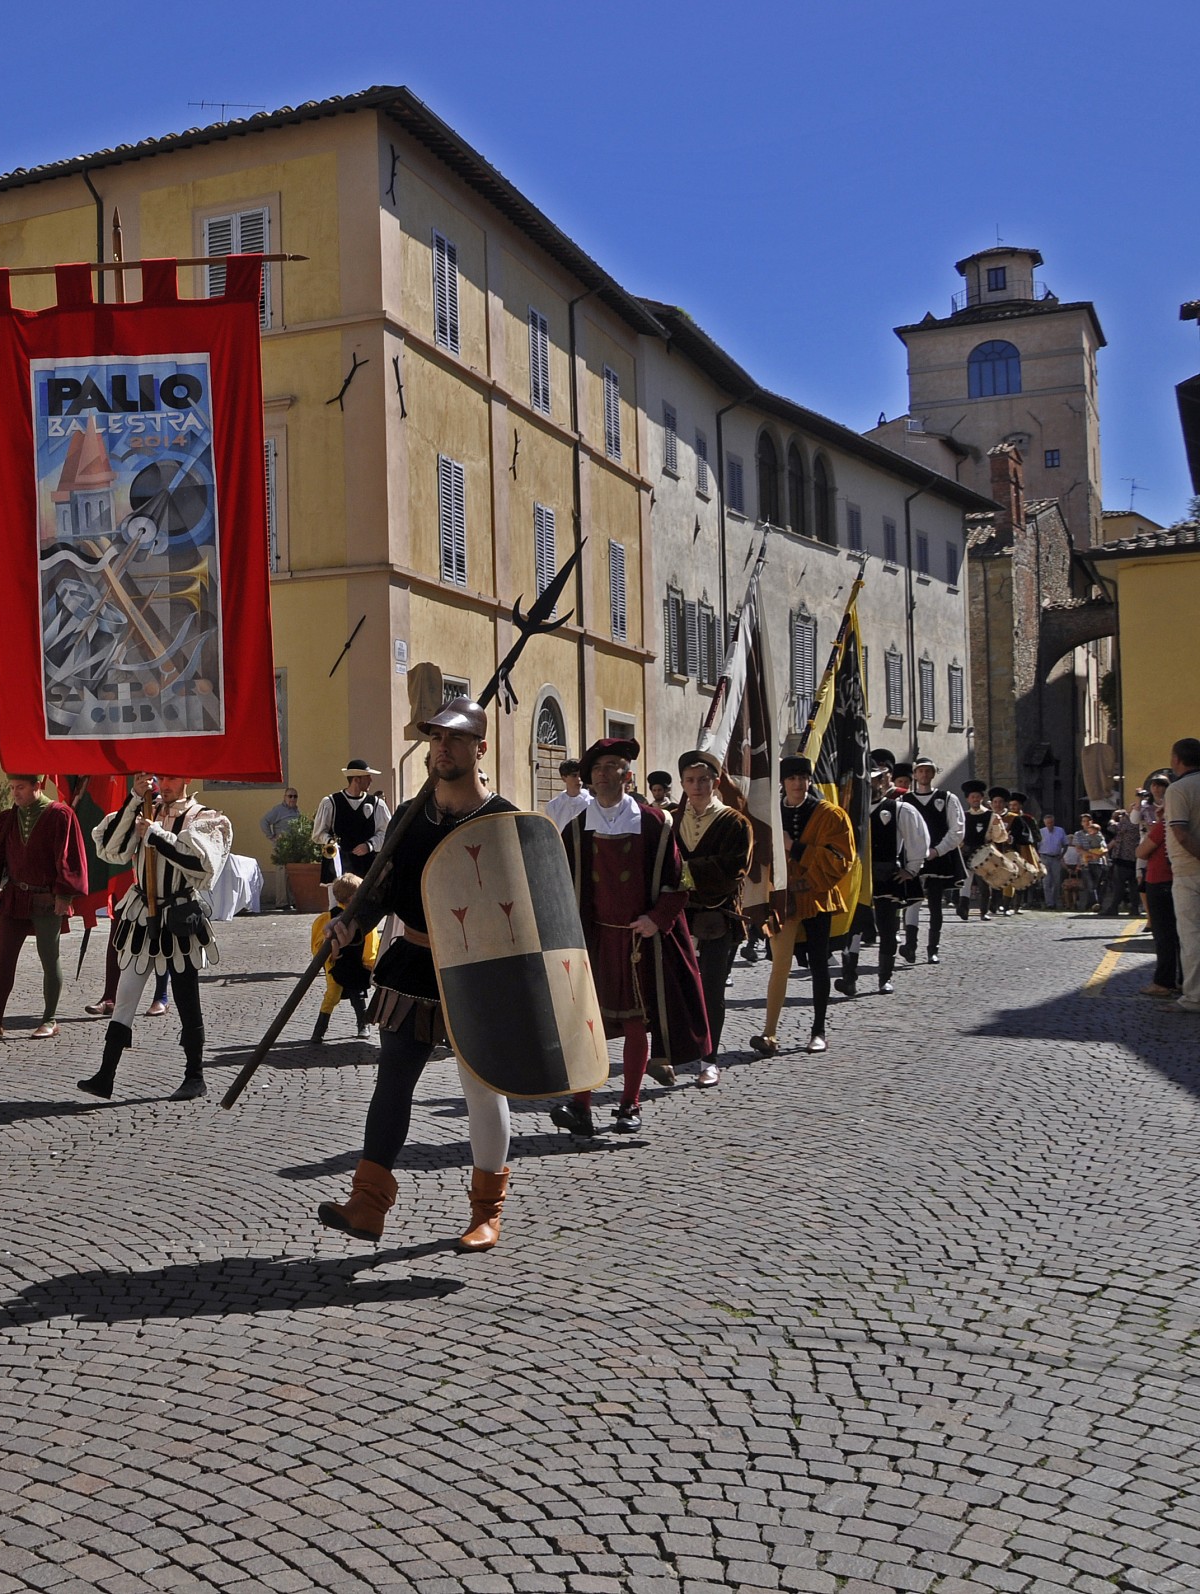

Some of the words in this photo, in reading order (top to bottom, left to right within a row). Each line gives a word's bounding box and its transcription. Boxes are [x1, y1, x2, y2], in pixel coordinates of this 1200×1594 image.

[47, 373, 203, 416] PALIO
[48, 411, 204, 437] BALESTRA
[130, 434, 188, 448] 2014
